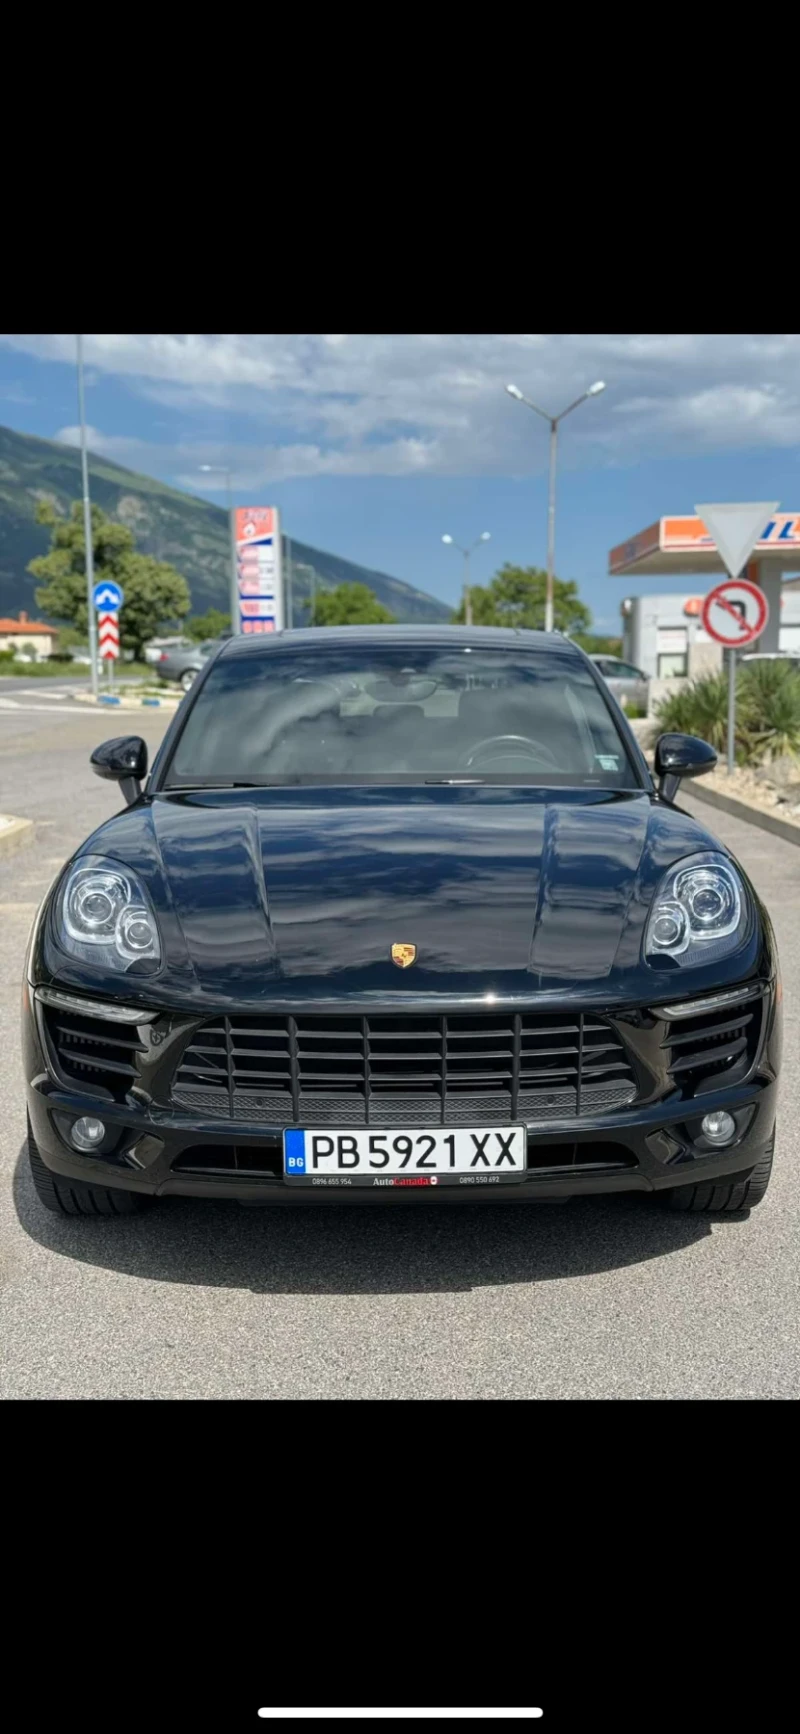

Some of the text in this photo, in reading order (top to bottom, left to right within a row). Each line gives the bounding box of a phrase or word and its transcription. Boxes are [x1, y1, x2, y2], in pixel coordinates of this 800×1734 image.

[312, 1132, 517, 1169] PB 5921 XX
[288, 1157, 304, 1168] BG
[373, 1177, 429, 1186] AutoCanada
[459, 1176, 474, 1184] 0890
